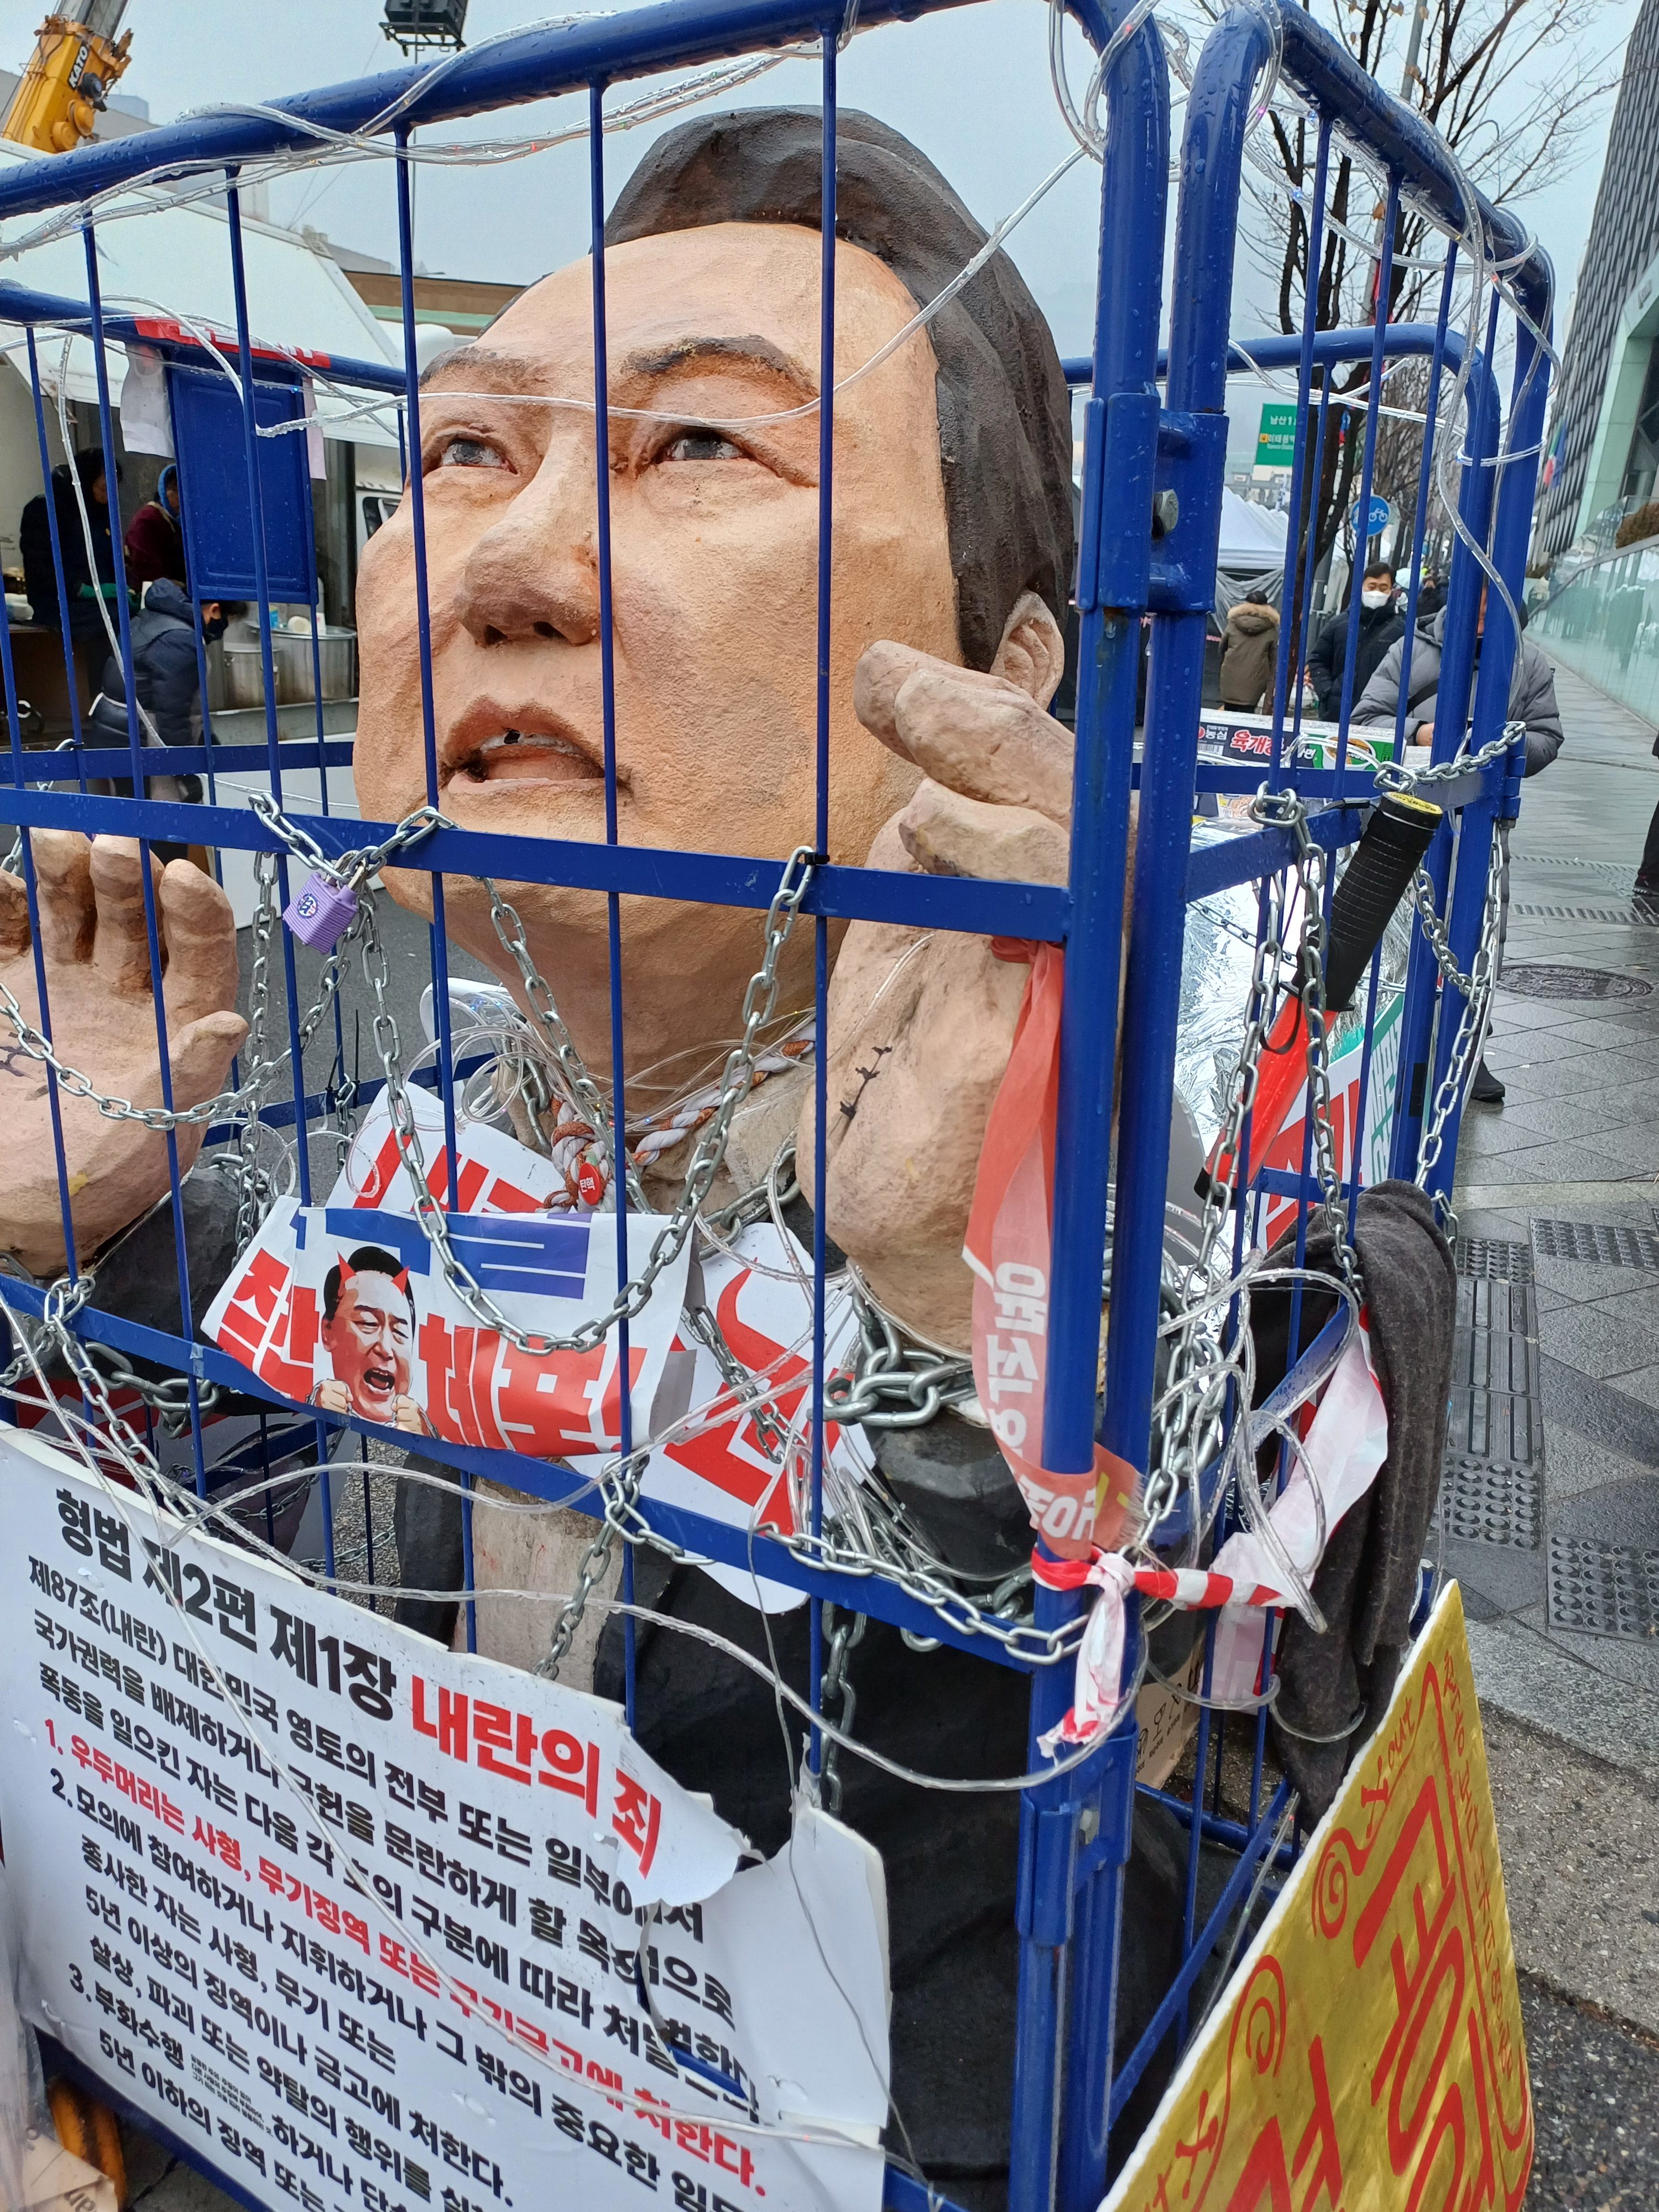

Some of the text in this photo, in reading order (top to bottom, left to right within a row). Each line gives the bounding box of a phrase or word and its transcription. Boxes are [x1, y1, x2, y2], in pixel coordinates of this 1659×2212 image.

[69, 46, 88, 88] KATO
[1205, 731, 1228, 741] 농심
[579, 1176, 596, 1193] 탄핵
[28, 1554, 166, 1666] 제87조(내란)
[172, 1641, 279, 1734] 대한민국
[286, 1709, 377, 1789] 영토의
[384, 1760, 448, 1824] 전부
[458, 1801, 533, 1867] 또는
[34, 1608, 145, 1707] 국가권력을
[150, 1681, 279, 1790] 배제하거나
[384, 1819, 517, 1927] 문란하게
[528, 1896, 567, 1949] 할
[56, 1488, 661, 1880] 형법 제2편 제1장 내란의 죄
[39, 1661, 105, 1731] 폭동을
[110, 1708, 181, 1781] 일으킨
[186, 1755, 238, 1817] 자는
[244, 1792, 299, 1855] 다음
[305, 1830, 335, 1878] 각
[411, 1894, 509, 1986] 구분에
[520, 1958, 594, 2029] 따라
[45, 1718, 64, 1756] 1.
[71, 1734, 185, 1835] 우두머리는
[191, 1814, 252, 1882] 사형,
[258, 1855, 371, 1956] 무기징역
[379, 1932, 441, 2000] 또는
[634, 2086, 766, 2197] 처한다.
[50, 1767, 73, 1808] 2.
[76, 1783, 143, 1857] 모의에
[147, 1833, 274, 1944] 참여하거나
[280, 1920, 427, 2042] 지휘하거나
[436, 2020, 468, 2067] 그
[474, 2044, 542, 2118] 밖의
[551, 2093, 660, 2192] 중요한
[81, 1833, 397, 2075] 종사한 자는 사형, 무기 또는
[68, 1963, 185, 2071] 3. 부화수행
[85, 1884, 513, 2208] 5년 이상의 징역이나 금고에 처한다.
[90, 1934, 142, 1999] 살상,
[147, 1974, 196, 2035] 파괴
[201, 2013, 251, 2075] 또는
[256, 2056, 337, 2138] 약탈의
[343, 2115, 432, 2204] 행위를
[99, 2027, 326, 2212] 5년 이하의 징역 또는
[272, 2113, 354, 2197] 하거나
